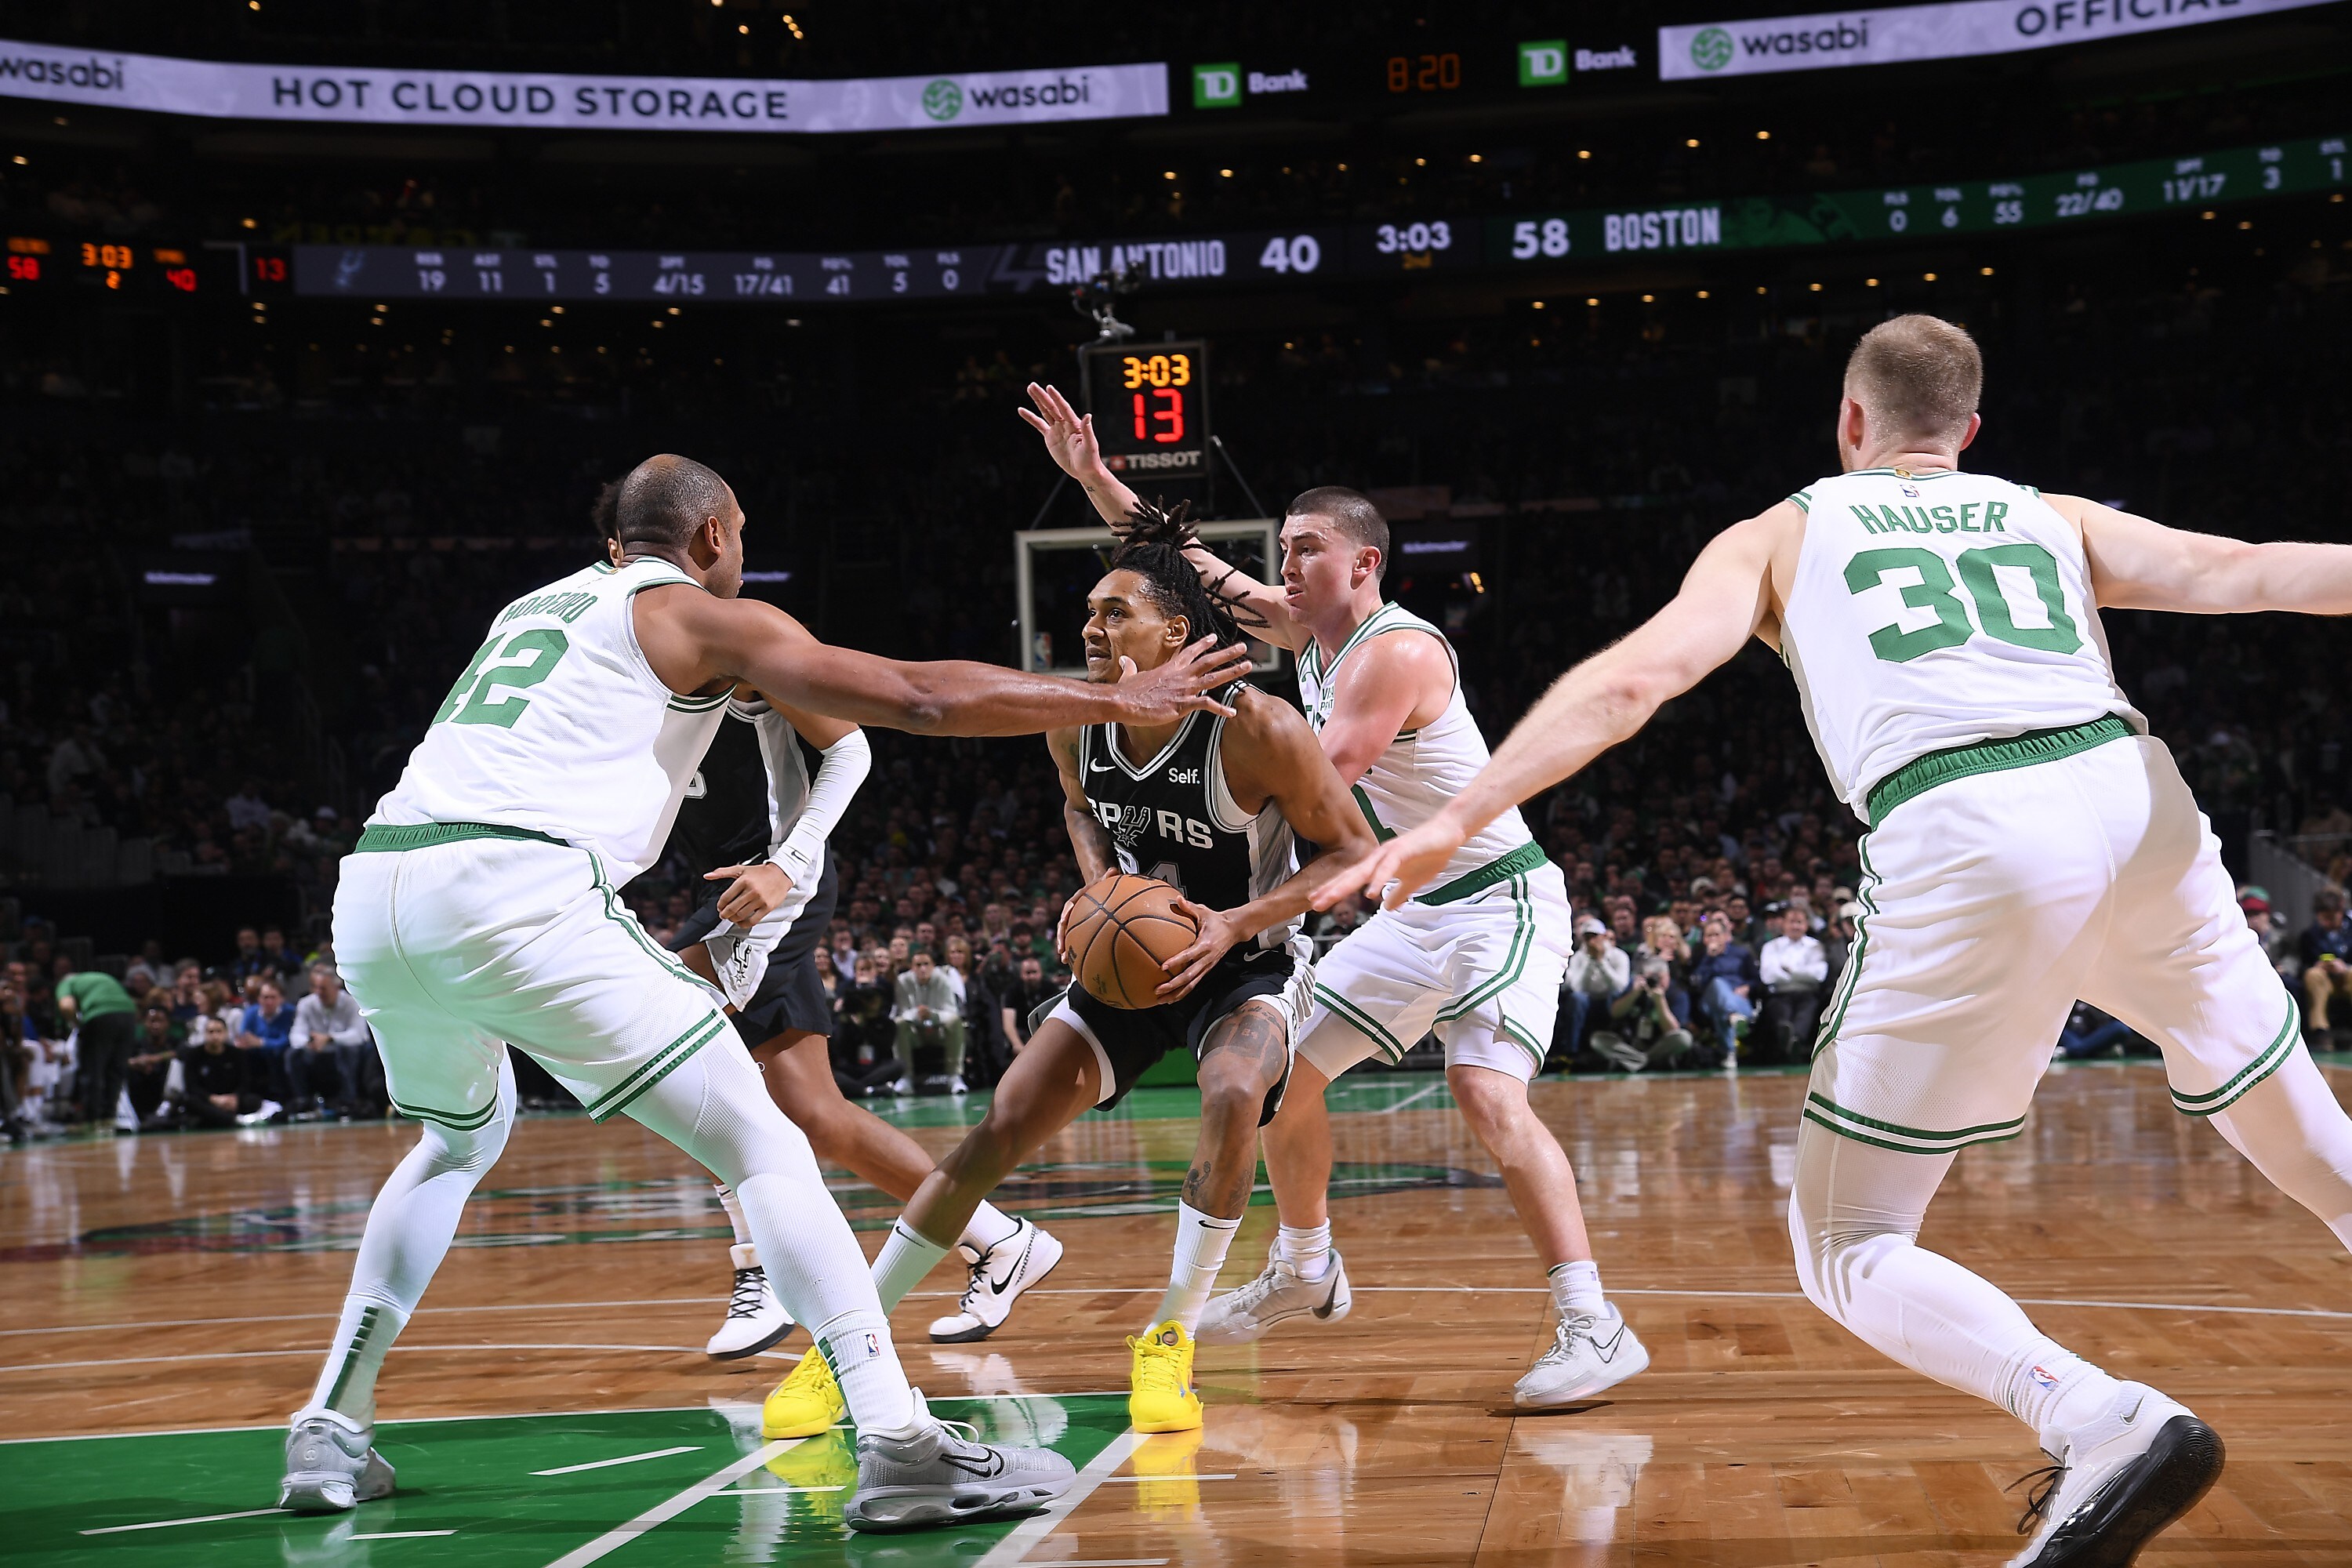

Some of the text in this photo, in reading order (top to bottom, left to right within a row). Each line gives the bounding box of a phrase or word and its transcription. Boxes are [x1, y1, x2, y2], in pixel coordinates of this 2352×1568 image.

[2016, 0, 2239, 37] OFFICI
[1742, 18, 1871, 56] wasabi
[0, 57, 124, 91] wasabi
[1529, 46, 1635, 75] TD Bank
[273, 78, 787, 119] HOT CLOUD STORAGE
[971, 76, 1090, 108] wasabi
[1201, 70, 1307, 97] TD Bank
[1889, 158, 2342, 231] 0 6 55 22/40 11/17 3 1
[1377, 221, 1450, 253] 3:03
[1513, 219, 1570, 259] 58
[1605, 208, 1720, 252] BOSTON
[8, 256, 39, 280] 58
[83, 243, 132, 269] 3:03
[256, 258, 286, 281] 13
[1047, 240, 1225, 283] SAN ANTONIO
[1260, 235, 1319, 273] 40
[167, 269, 196, 292] 40
[419, 269, 959, 295] 19 11 1 5 4/15 17/41 41 5 0
[1123, 354, 1191, 391] 3:03
[1133, 388, 1184, 443] 13
[1126, 451, 1201, 469] TISSOT
[1849, 501, 2009, 535] HAUSER
[498, 592, 598, 624] HORFORD
[1843, 543, 2085, 663] 30
[429, 629, 569, 729] 42
[1168, 768, 1200, 785] Self.
